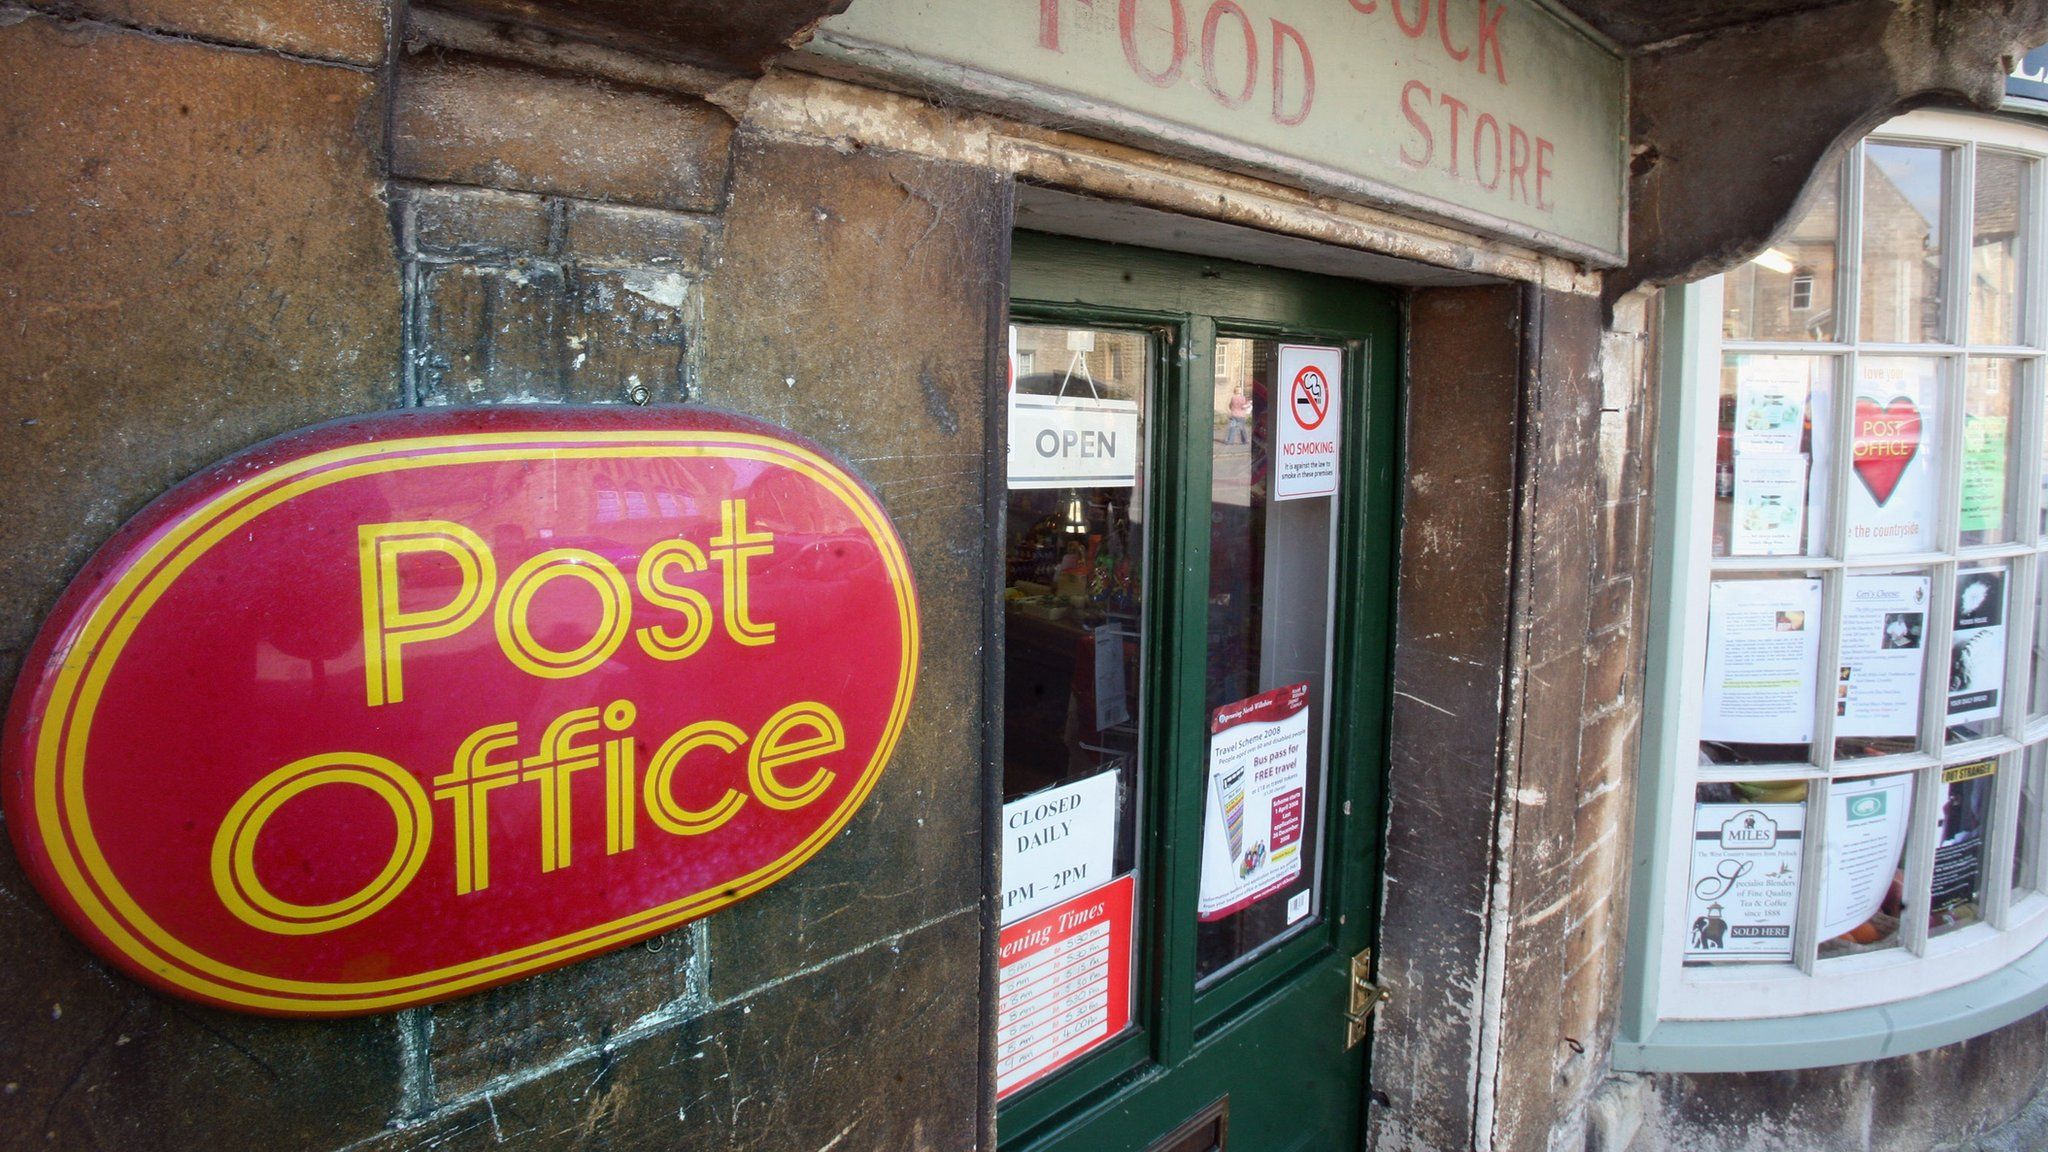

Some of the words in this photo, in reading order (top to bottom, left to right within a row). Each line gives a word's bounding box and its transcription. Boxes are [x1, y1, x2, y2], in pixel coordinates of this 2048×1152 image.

[1341, 0, 1508, 86] OCK
[1398, 79, 1554, 211] STORE
[1863, 420, 1904, 437] POST
[1035, 428, 1116, 458] OPEN
[1283, 443, 1296, 456] NO
[1854, 440, 1909, 457] OFFICE
[1282, 471, 1297, 480] smoke
[1302, 470, 1314, 478] these
[1314, 470, 1333, 478] premises
[1294, 462, 1310, 471] against
[1855, 524, 1870, 538] the
[1873, 522, 1920, 539] countryside
[357, 497, 777, 707] Post
[1215, 742, 1237, 757] Travel
[1238, 734, 1262, 749] Scheme
[1264, 726, 1281, 739] 2008
[1219, 753, 1236, 765] People
[1253, 756, 1268, 767] Bus
[1269, 750, 1287, 763] pass
[1288, 744, 1299, 754] for
[1254, 767, 1273, 782] FREE
[1275, 758, 1297, 772] travel
[1273, 796, 1289, 807] Scheme
[209, 698, 846, 936] Office
[1009, 793, 1082, 830] CLOSED
[1282, 811, 1291, 819] Last
[1017, 819, 1072, 854] DAILY
[1728, 830, 1771, 841] MILES
[1053, 863, 1088, 890] 2PM
[1766, 879, 1796, 887] Blenders
[1765, 890, 1793, 898] Quality
[1000, 925, 1053, 958] ening
[1058, 902, 1105, 932] Times
[1732, 928, 1759, 936] SOLD
[1761, 927, 1788, 936] HERE
